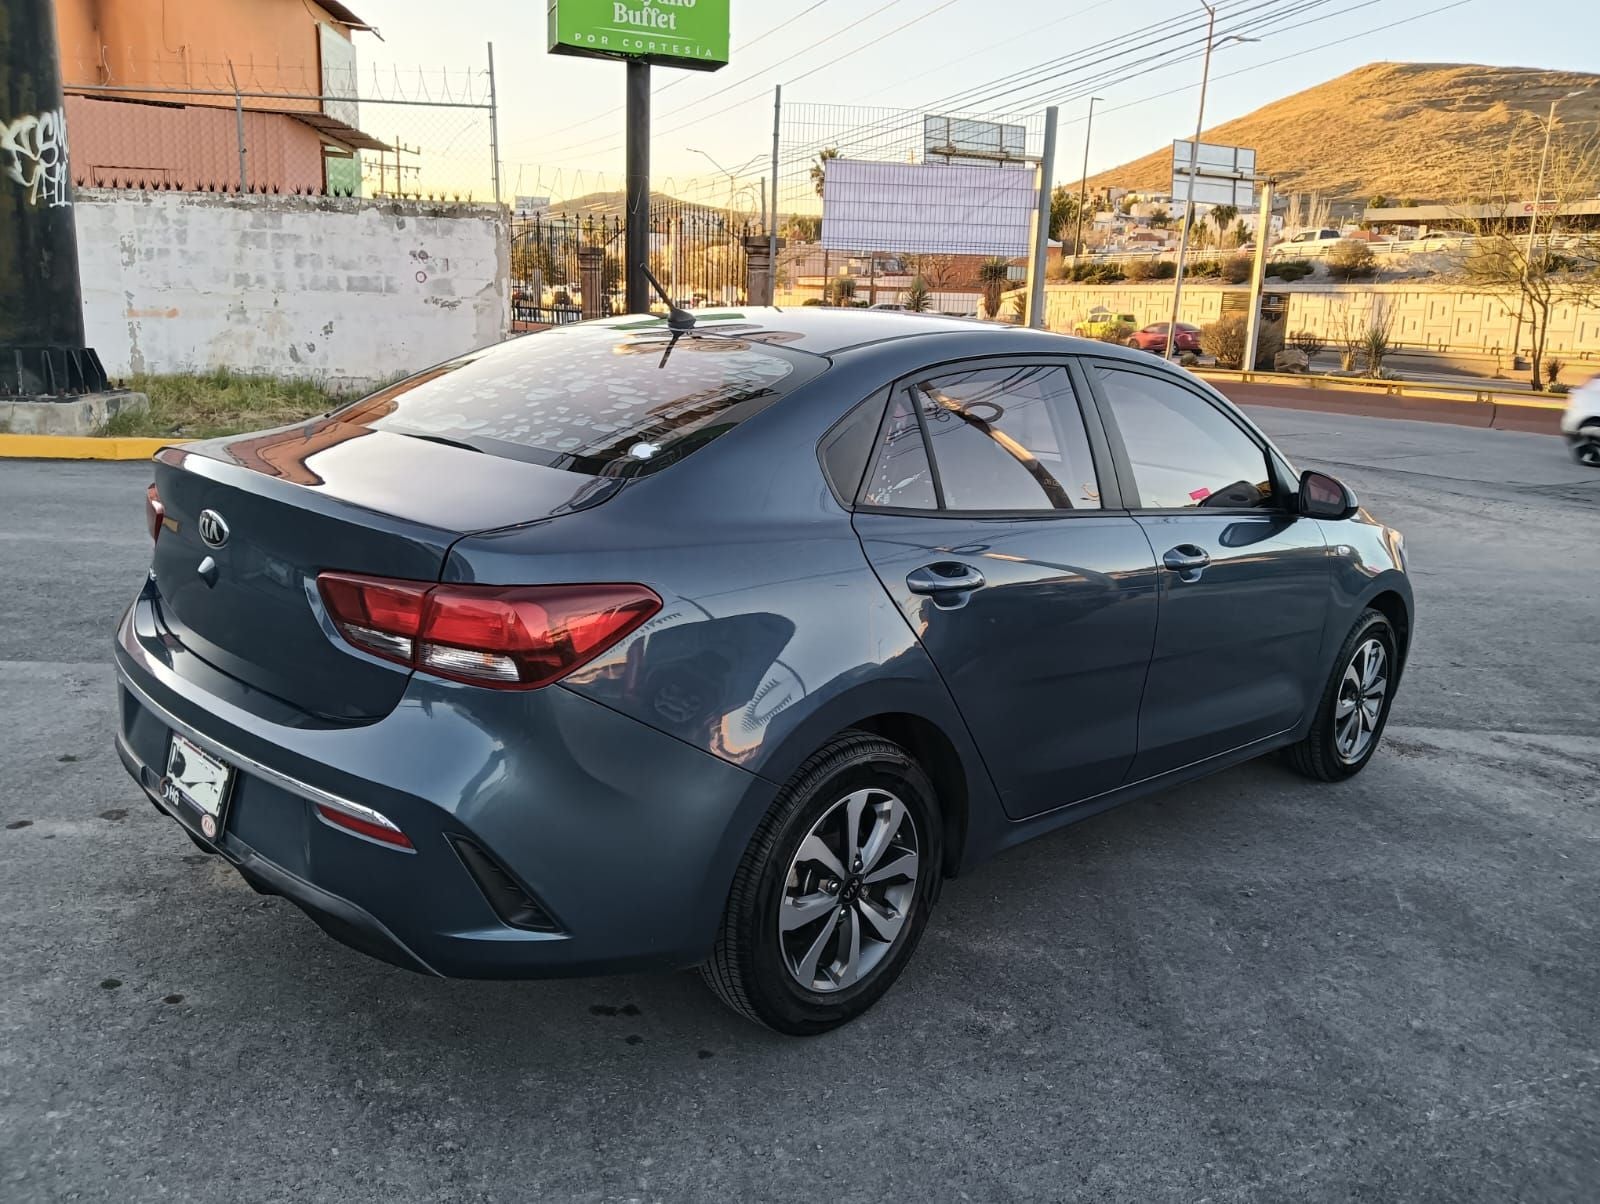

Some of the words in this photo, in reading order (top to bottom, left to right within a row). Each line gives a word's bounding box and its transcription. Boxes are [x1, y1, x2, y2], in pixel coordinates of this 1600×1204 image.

[613, 2, 677, 30] Buffet
[574, 33, 609, 44] POR
[622, 38, 713, 57] CORTESÍA
